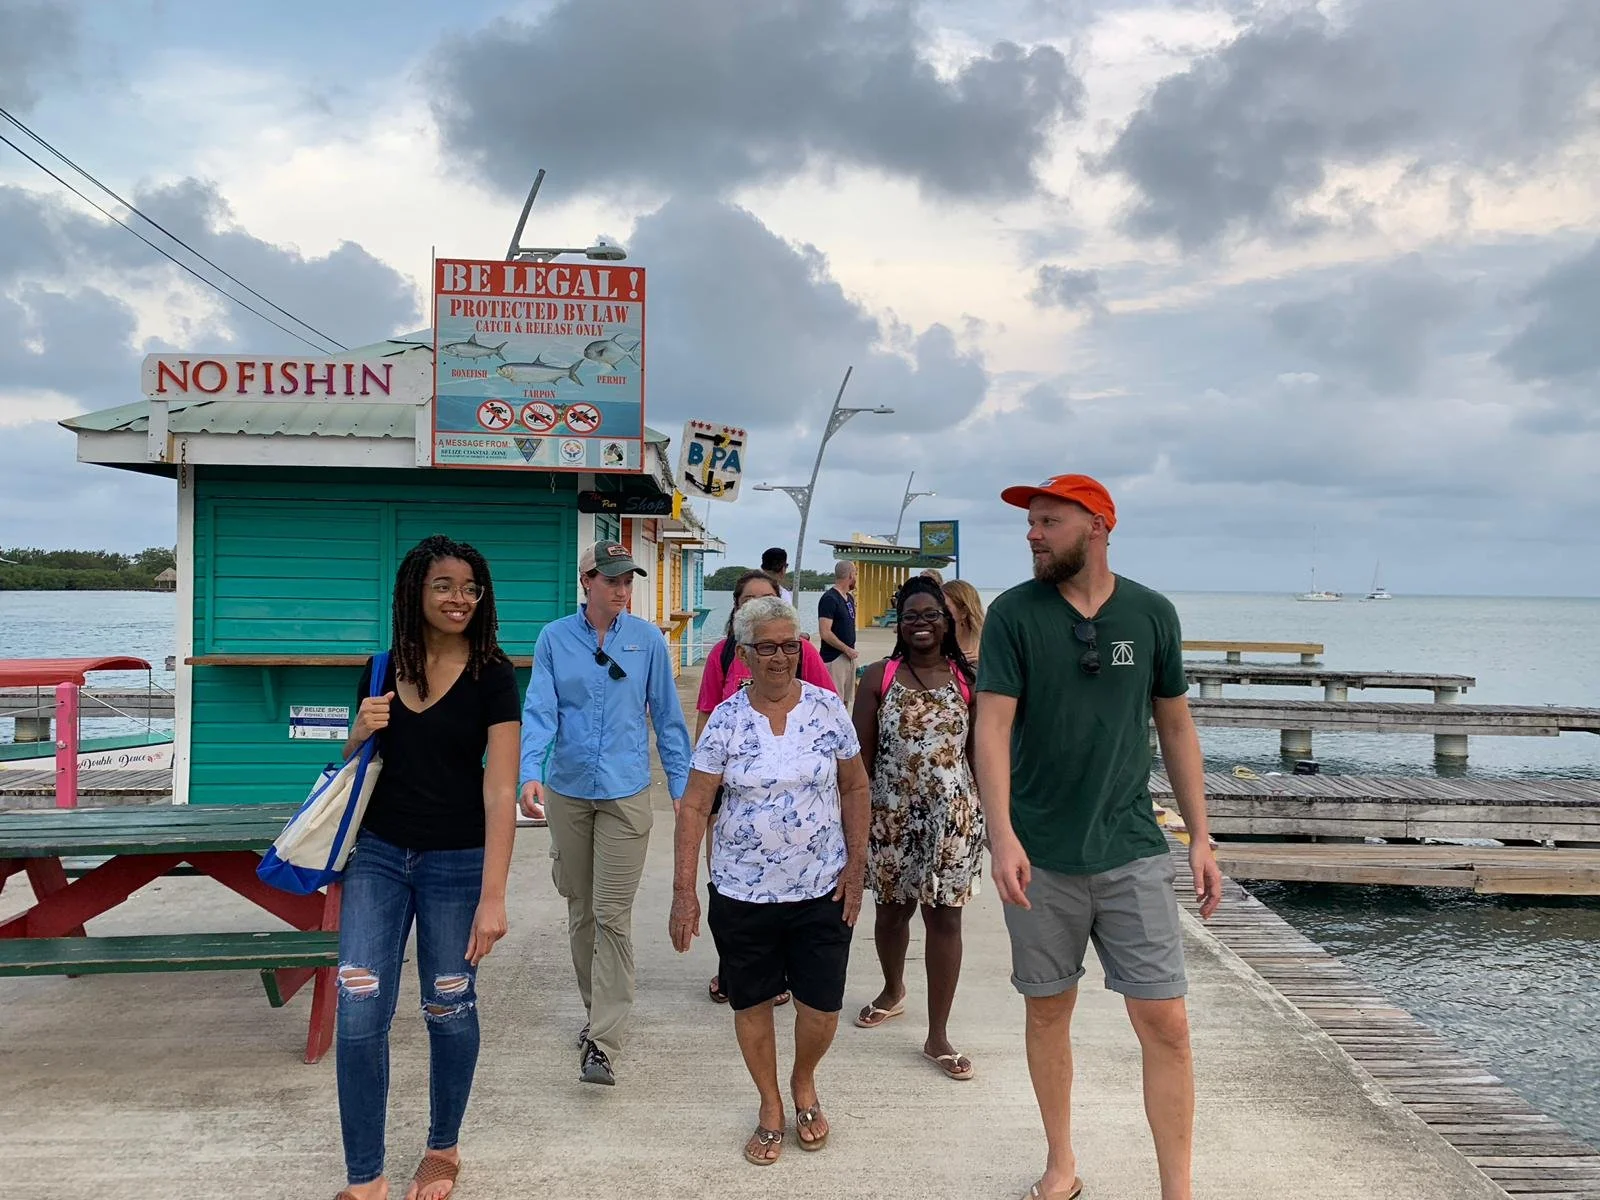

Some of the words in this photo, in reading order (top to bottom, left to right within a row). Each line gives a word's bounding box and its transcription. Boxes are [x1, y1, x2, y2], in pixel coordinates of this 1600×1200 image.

[441, 263, 491, 292] BE
[502, 265, 618, 298] LEGAL
[450, 299, 558, 321] PROTECTED
[564, 303, 587, 322] BY
[592, 304, 629, 323] LAW
[475, 319, 511, 333] CATCH
[514, 321, 522, 333] &
[526, 322, 573, 335] RELEASE
[576, 323, 604, 336] ONLY
[451, 368, 488, 379] BONEFISH
[596, 375, 628, 385] PERMIT
[523, 389, 556, 398] TARPON
[445, 439, 484, 447] MESSAGE
[624, 496, 667, 513] Shop
[80, 756, 112, 769] Double
[118, 754, 146, 767] Deuce
